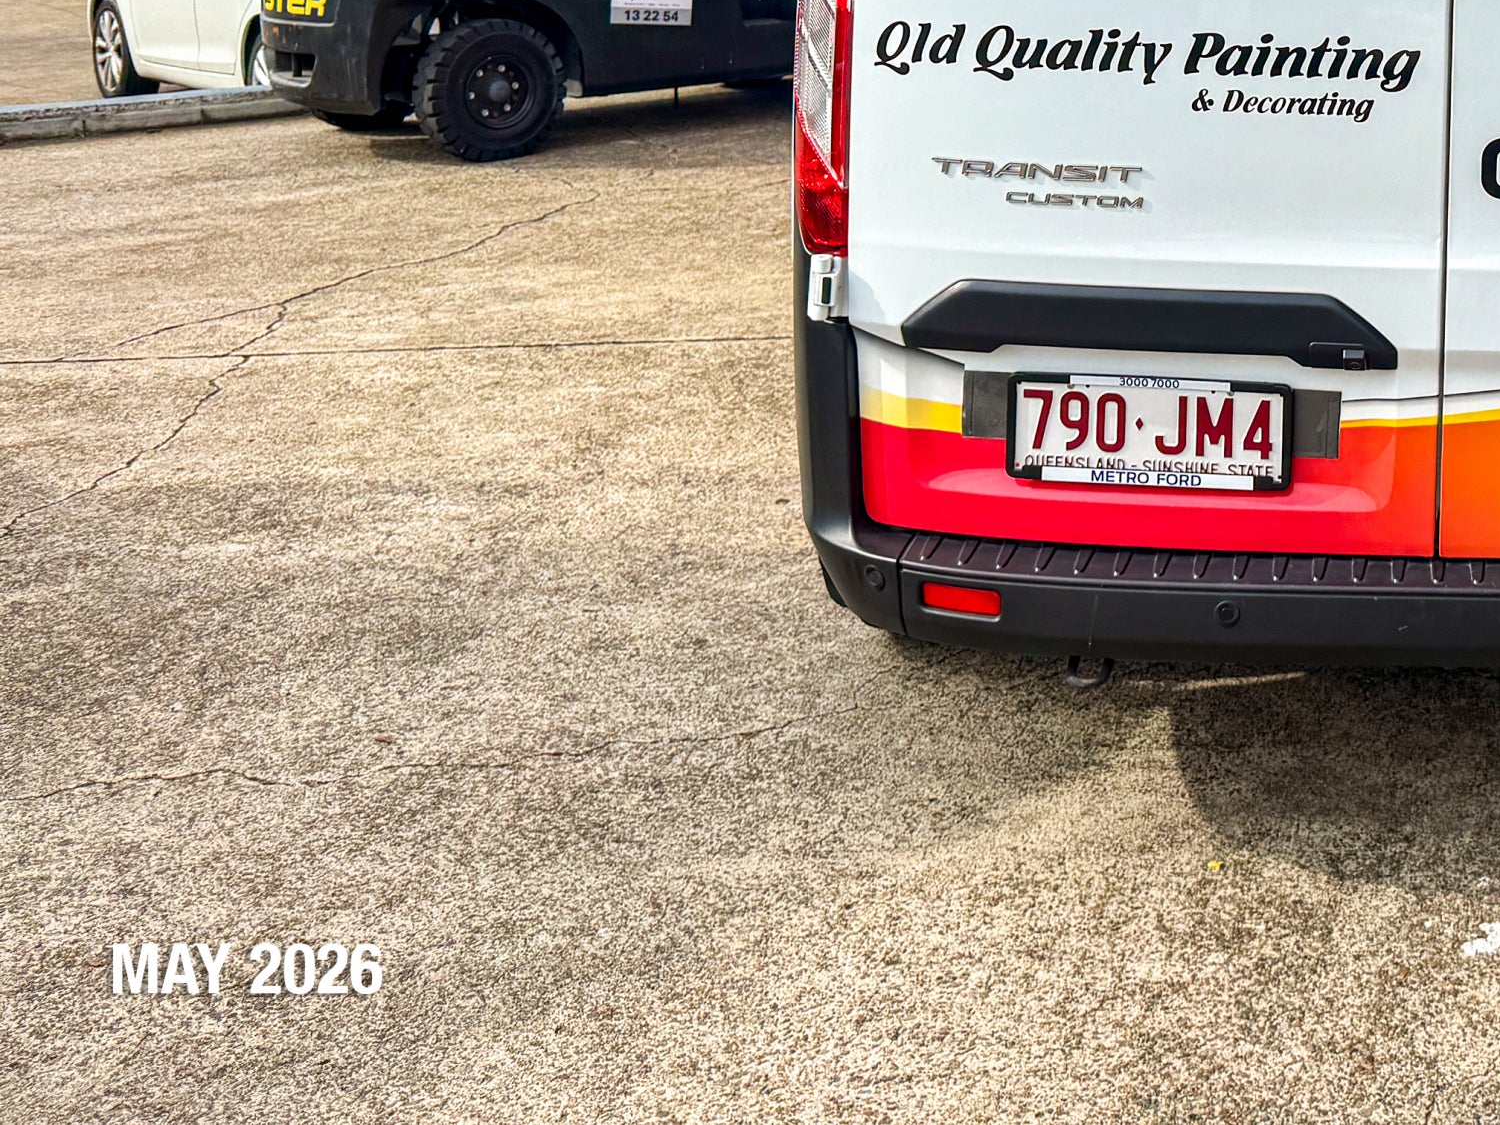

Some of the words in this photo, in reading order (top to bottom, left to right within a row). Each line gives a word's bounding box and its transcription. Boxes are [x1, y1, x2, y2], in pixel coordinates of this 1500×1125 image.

[624, 10, 640, 21] 13
[643, 10, 660, 21] 22
[663, 11, 679, 22] 54
[874, 20, 966, 76] Qld
[972, 25, 1172, 85] Quality
[1184, 32, 1421, 93] Painting
[1191, 89, 1214, 113] &
[1222, 89, 1374, 123] Decorating
[931, 156, 1143, 183] TRANSIT
[1005, 191, 1145, 209] CUSTOM
[1119, 377, 1148, 388] 3000
[1150, 378, 1180, 389] 7000
[1091, 470, 1150, 485] METRO
[1156, 473, 1202, 487] FORD
